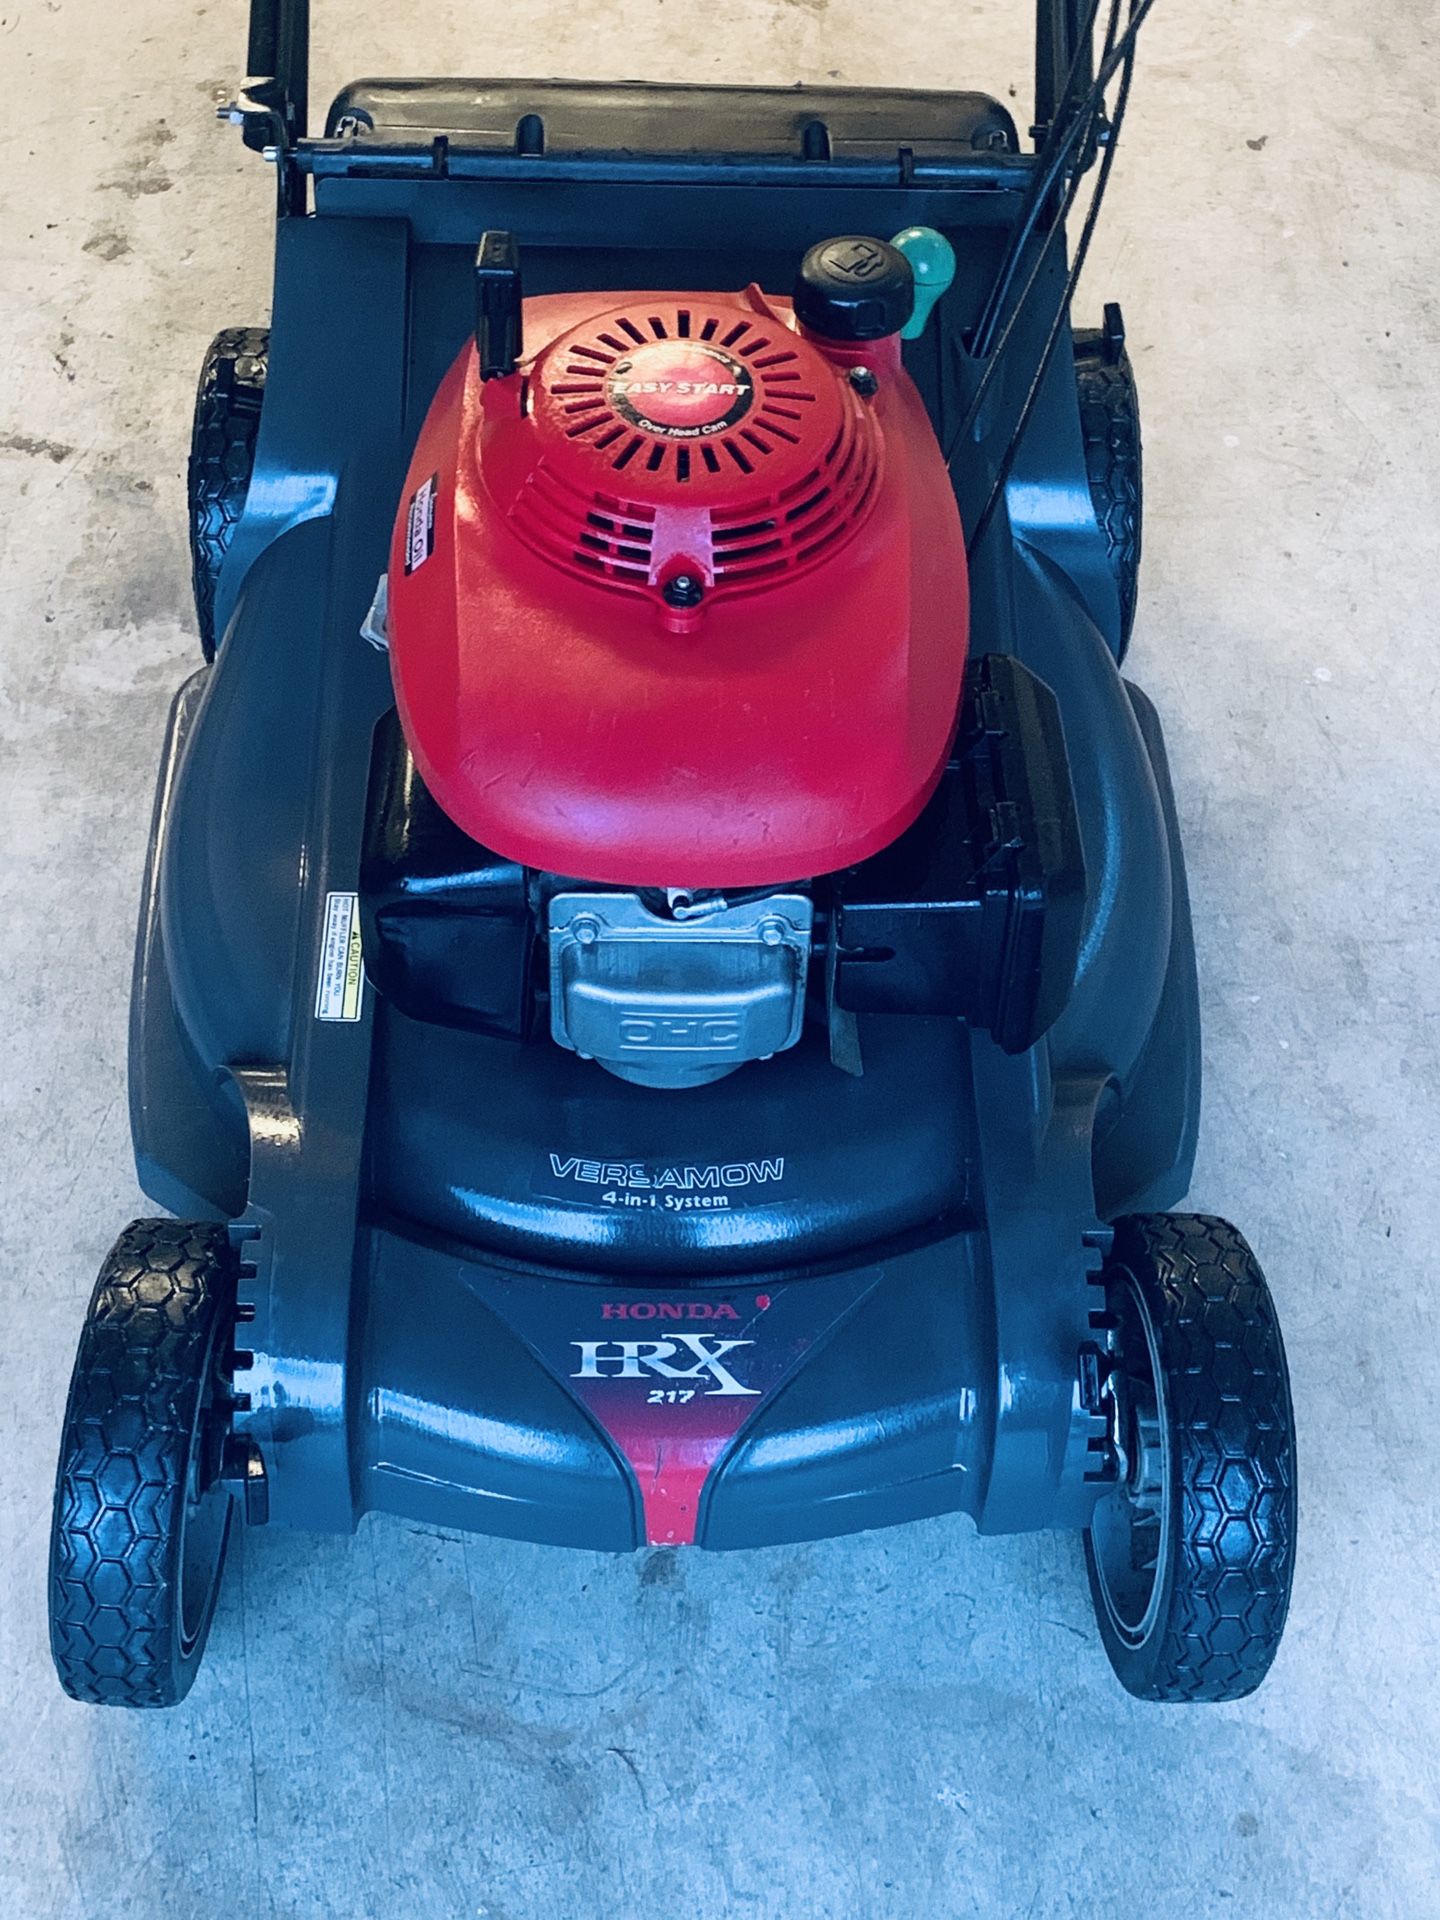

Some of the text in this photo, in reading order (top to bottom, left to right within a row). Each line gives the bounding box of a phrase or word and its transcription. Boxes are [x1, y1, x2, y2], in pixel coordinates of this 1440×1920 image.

[613, 381, 750, 396] EASY START
[638, 418, 728, 437] Over Head Cam
[413, 487, 427, 563] Honda Oil
[339, 915, 349, 944] MUFFLER
[337, 946, 345, 960] CAN
[335, 962, 344, 980] BURN
[348, 942, 360, 985] CAUTION
[333, 983, 342, 996] YOU
[549, 1153, 785, 1190] VERSAMOW
[602, 1191, 729, 1212] 4-in-1 System
[601, 1303, 741, 1320] HONDA
[569, 1333, 762, 1395] HRX
[647, 1389, 696, 1405] 217
